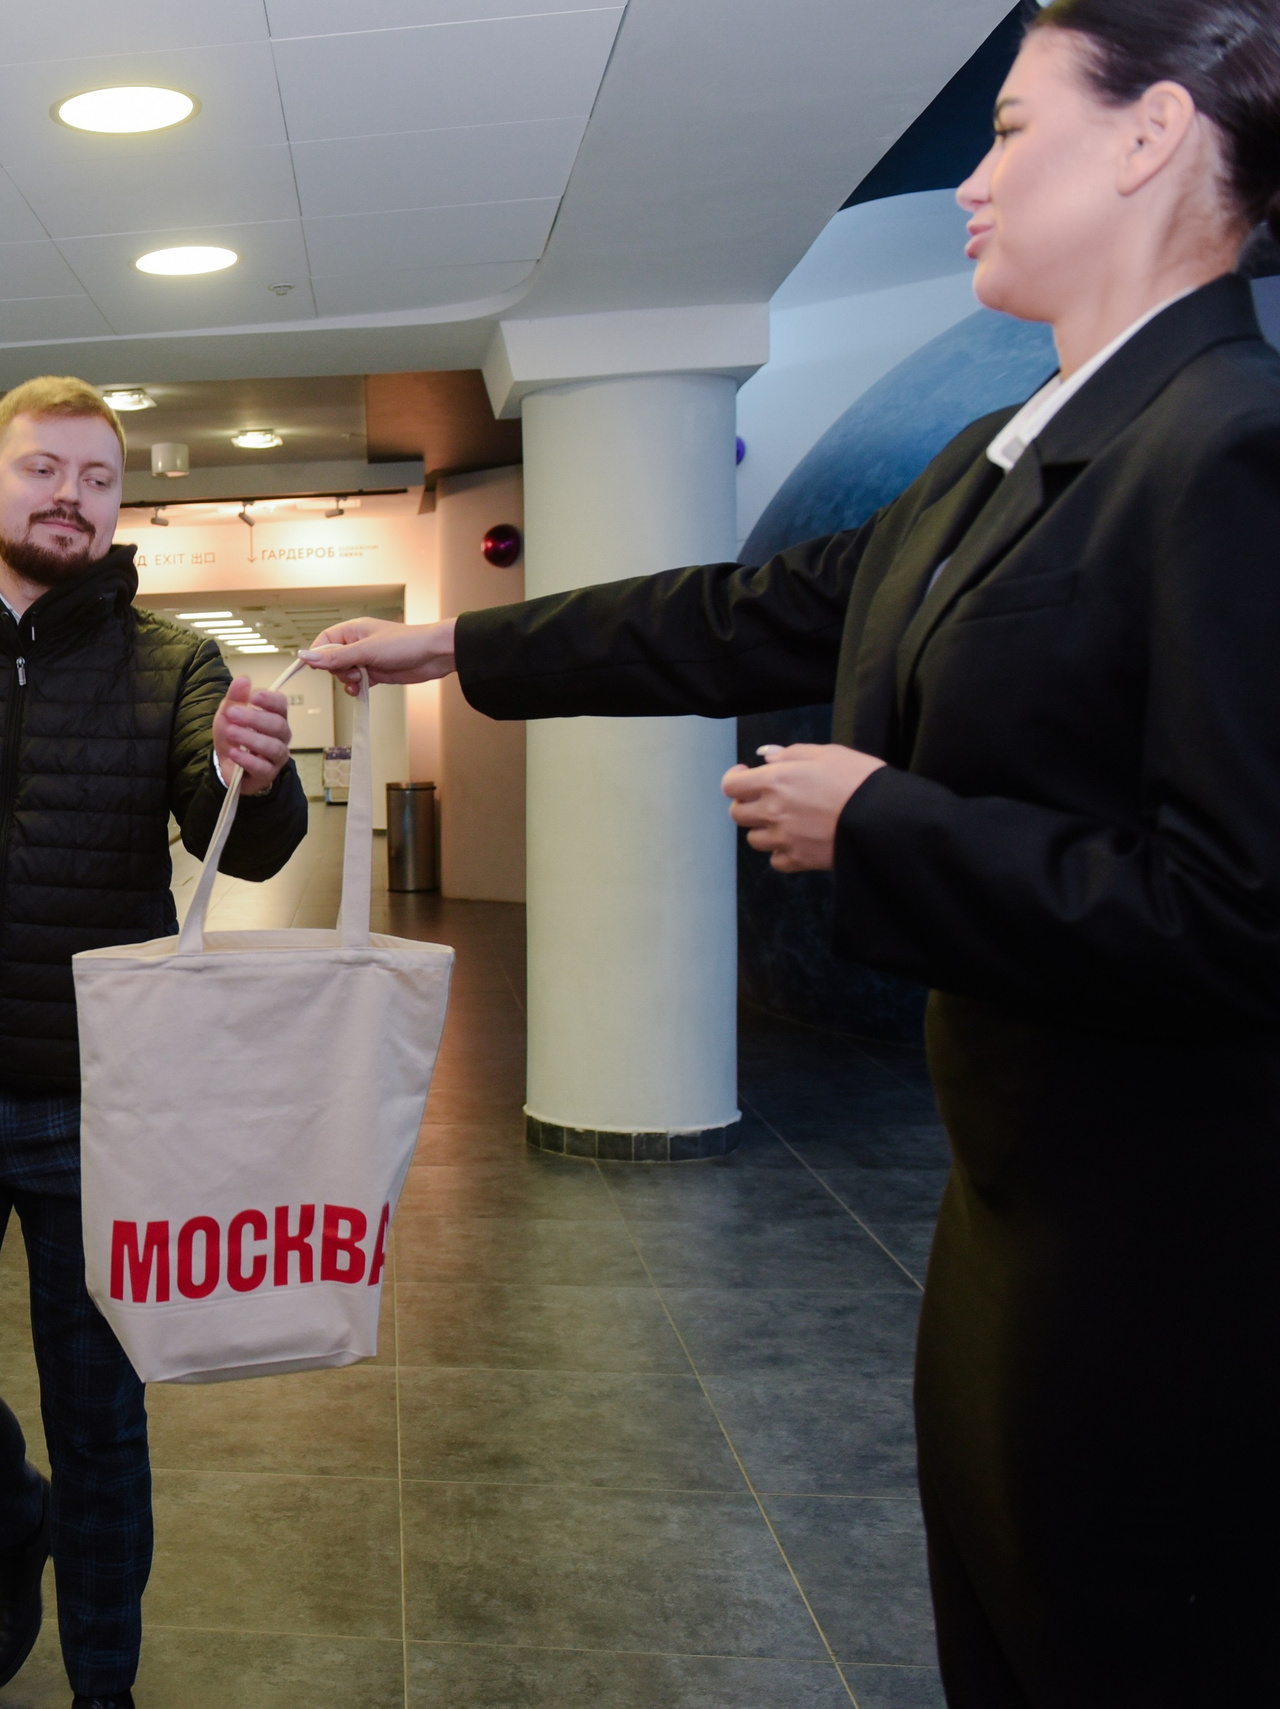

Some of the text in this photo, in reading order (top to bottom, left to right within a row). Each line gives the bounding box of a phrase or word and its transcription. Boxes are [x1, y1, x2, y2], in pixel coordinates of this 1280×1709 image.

[154, 552, 185, 566] EXIT
[190, 551, 216, 565] 出口
[261, 546, 336, 561] ГАРДЕРОБ
